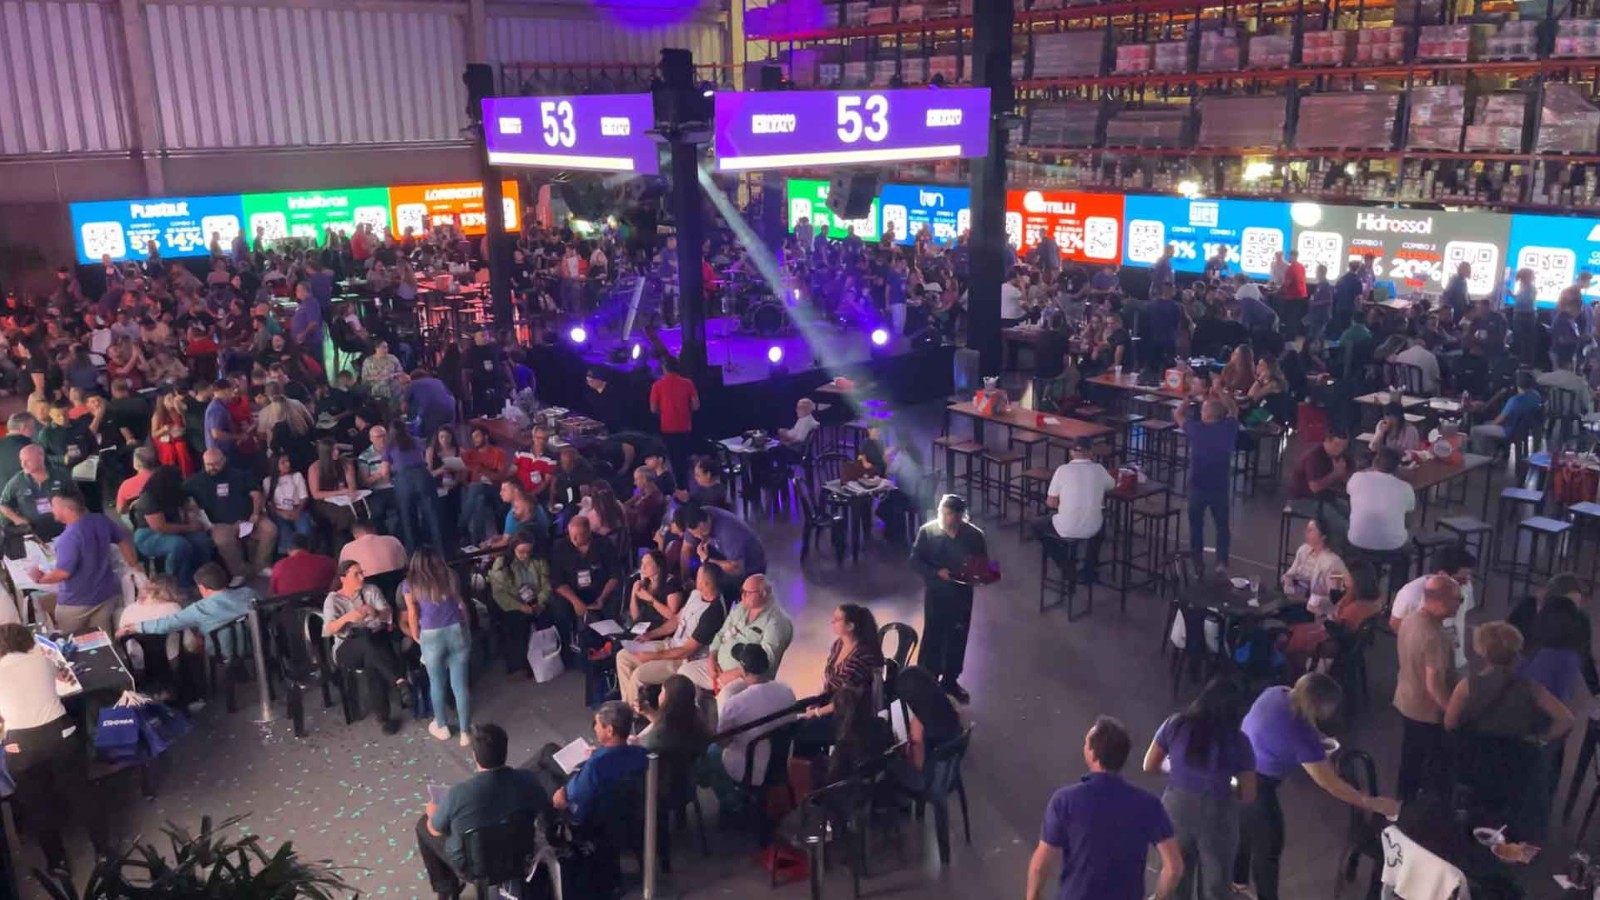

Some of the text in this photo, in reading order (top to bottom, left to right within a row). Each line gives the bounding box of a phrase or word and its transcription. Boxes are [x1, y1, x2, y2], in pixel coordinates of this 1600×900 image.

[541, 101, 576, 148] 53
[837, 94, 889, 143] 53
[1356, 212, 1433, 234] Hidrossol
[1352, 238, 1379, 247] COMBO
[1402, 241, 1430, 250] COMBO
[1389, 258, 1442, 281] 20%
